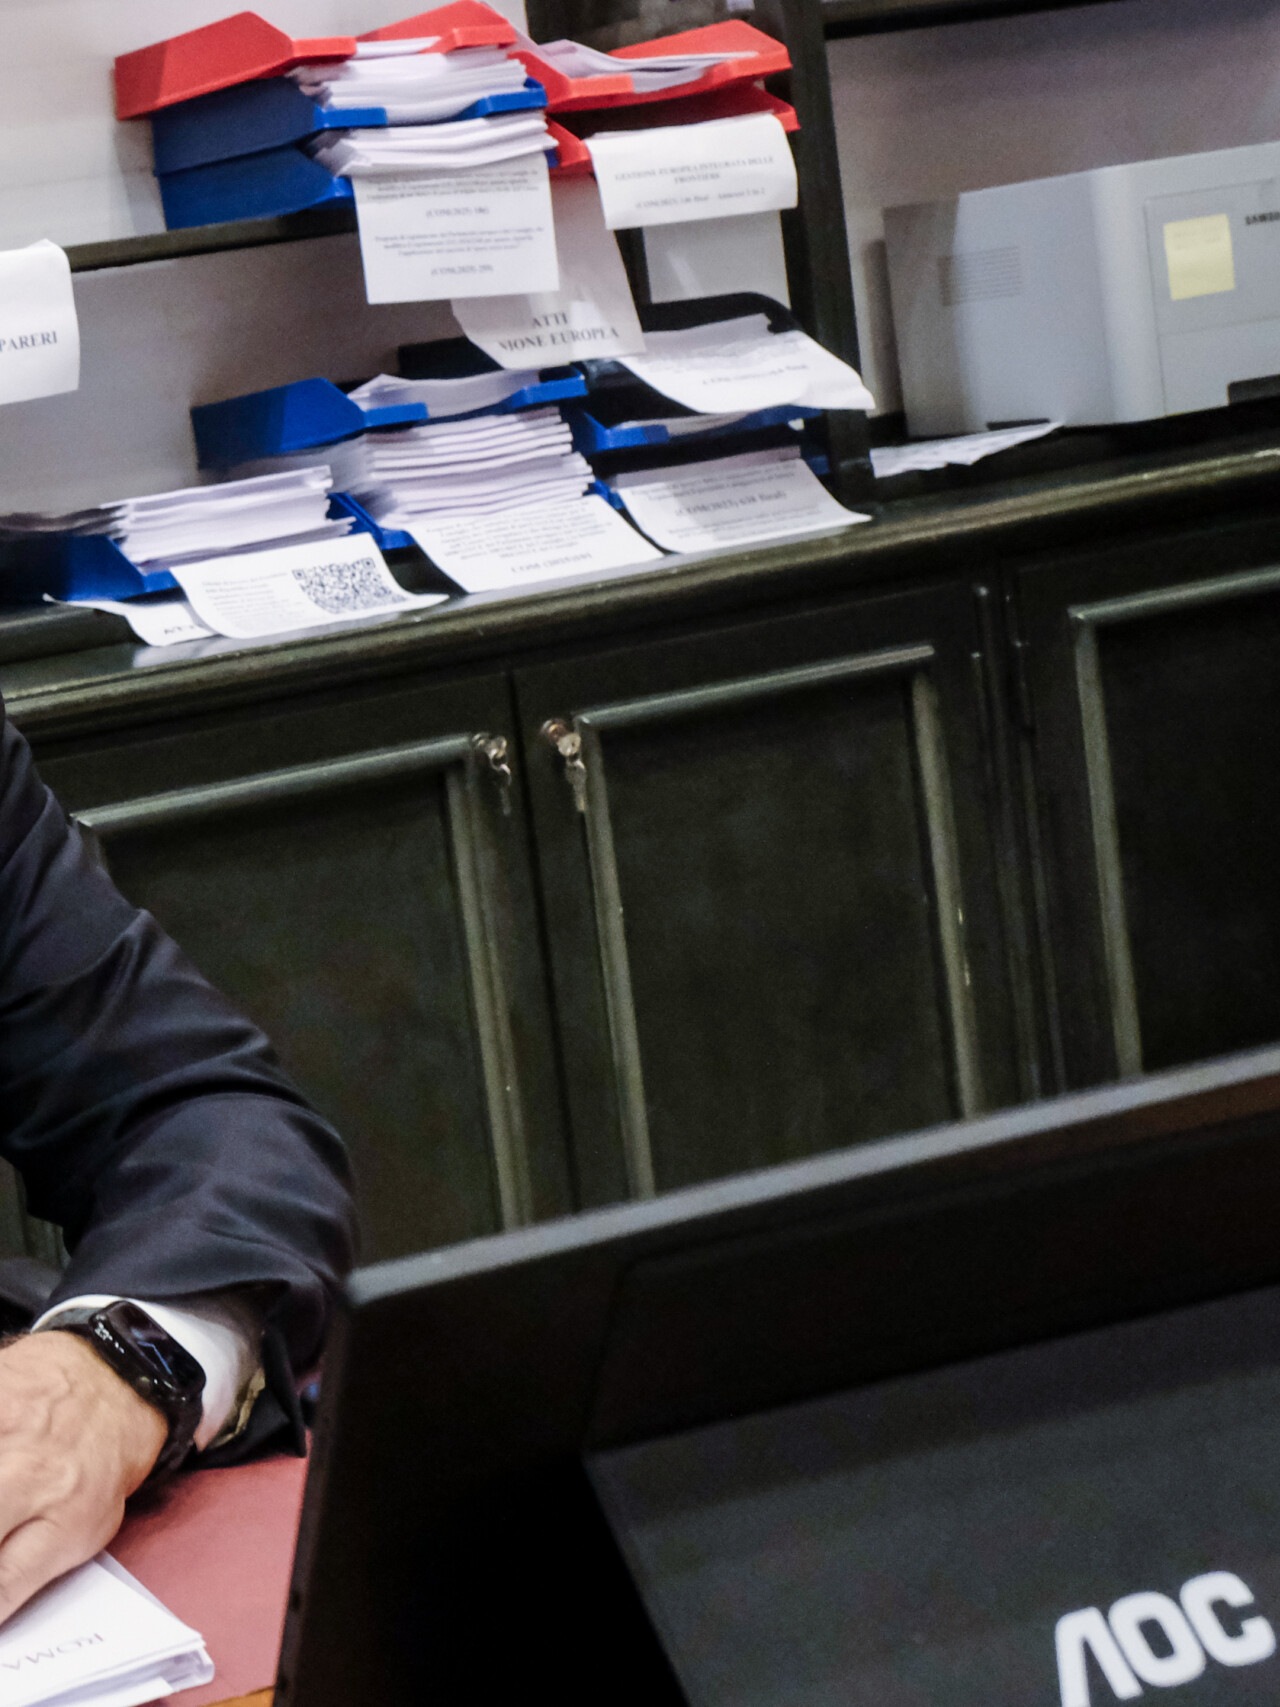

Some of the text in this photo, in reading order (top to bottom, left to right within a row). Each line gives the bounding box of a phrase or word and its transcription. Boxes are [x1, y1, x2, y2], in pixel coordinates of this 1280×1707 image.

[532, 312, 569, 329] ATTI
[549, 326, 620, 346] EUROPEA
[1055, 1570, 1277, 1707] AOC
